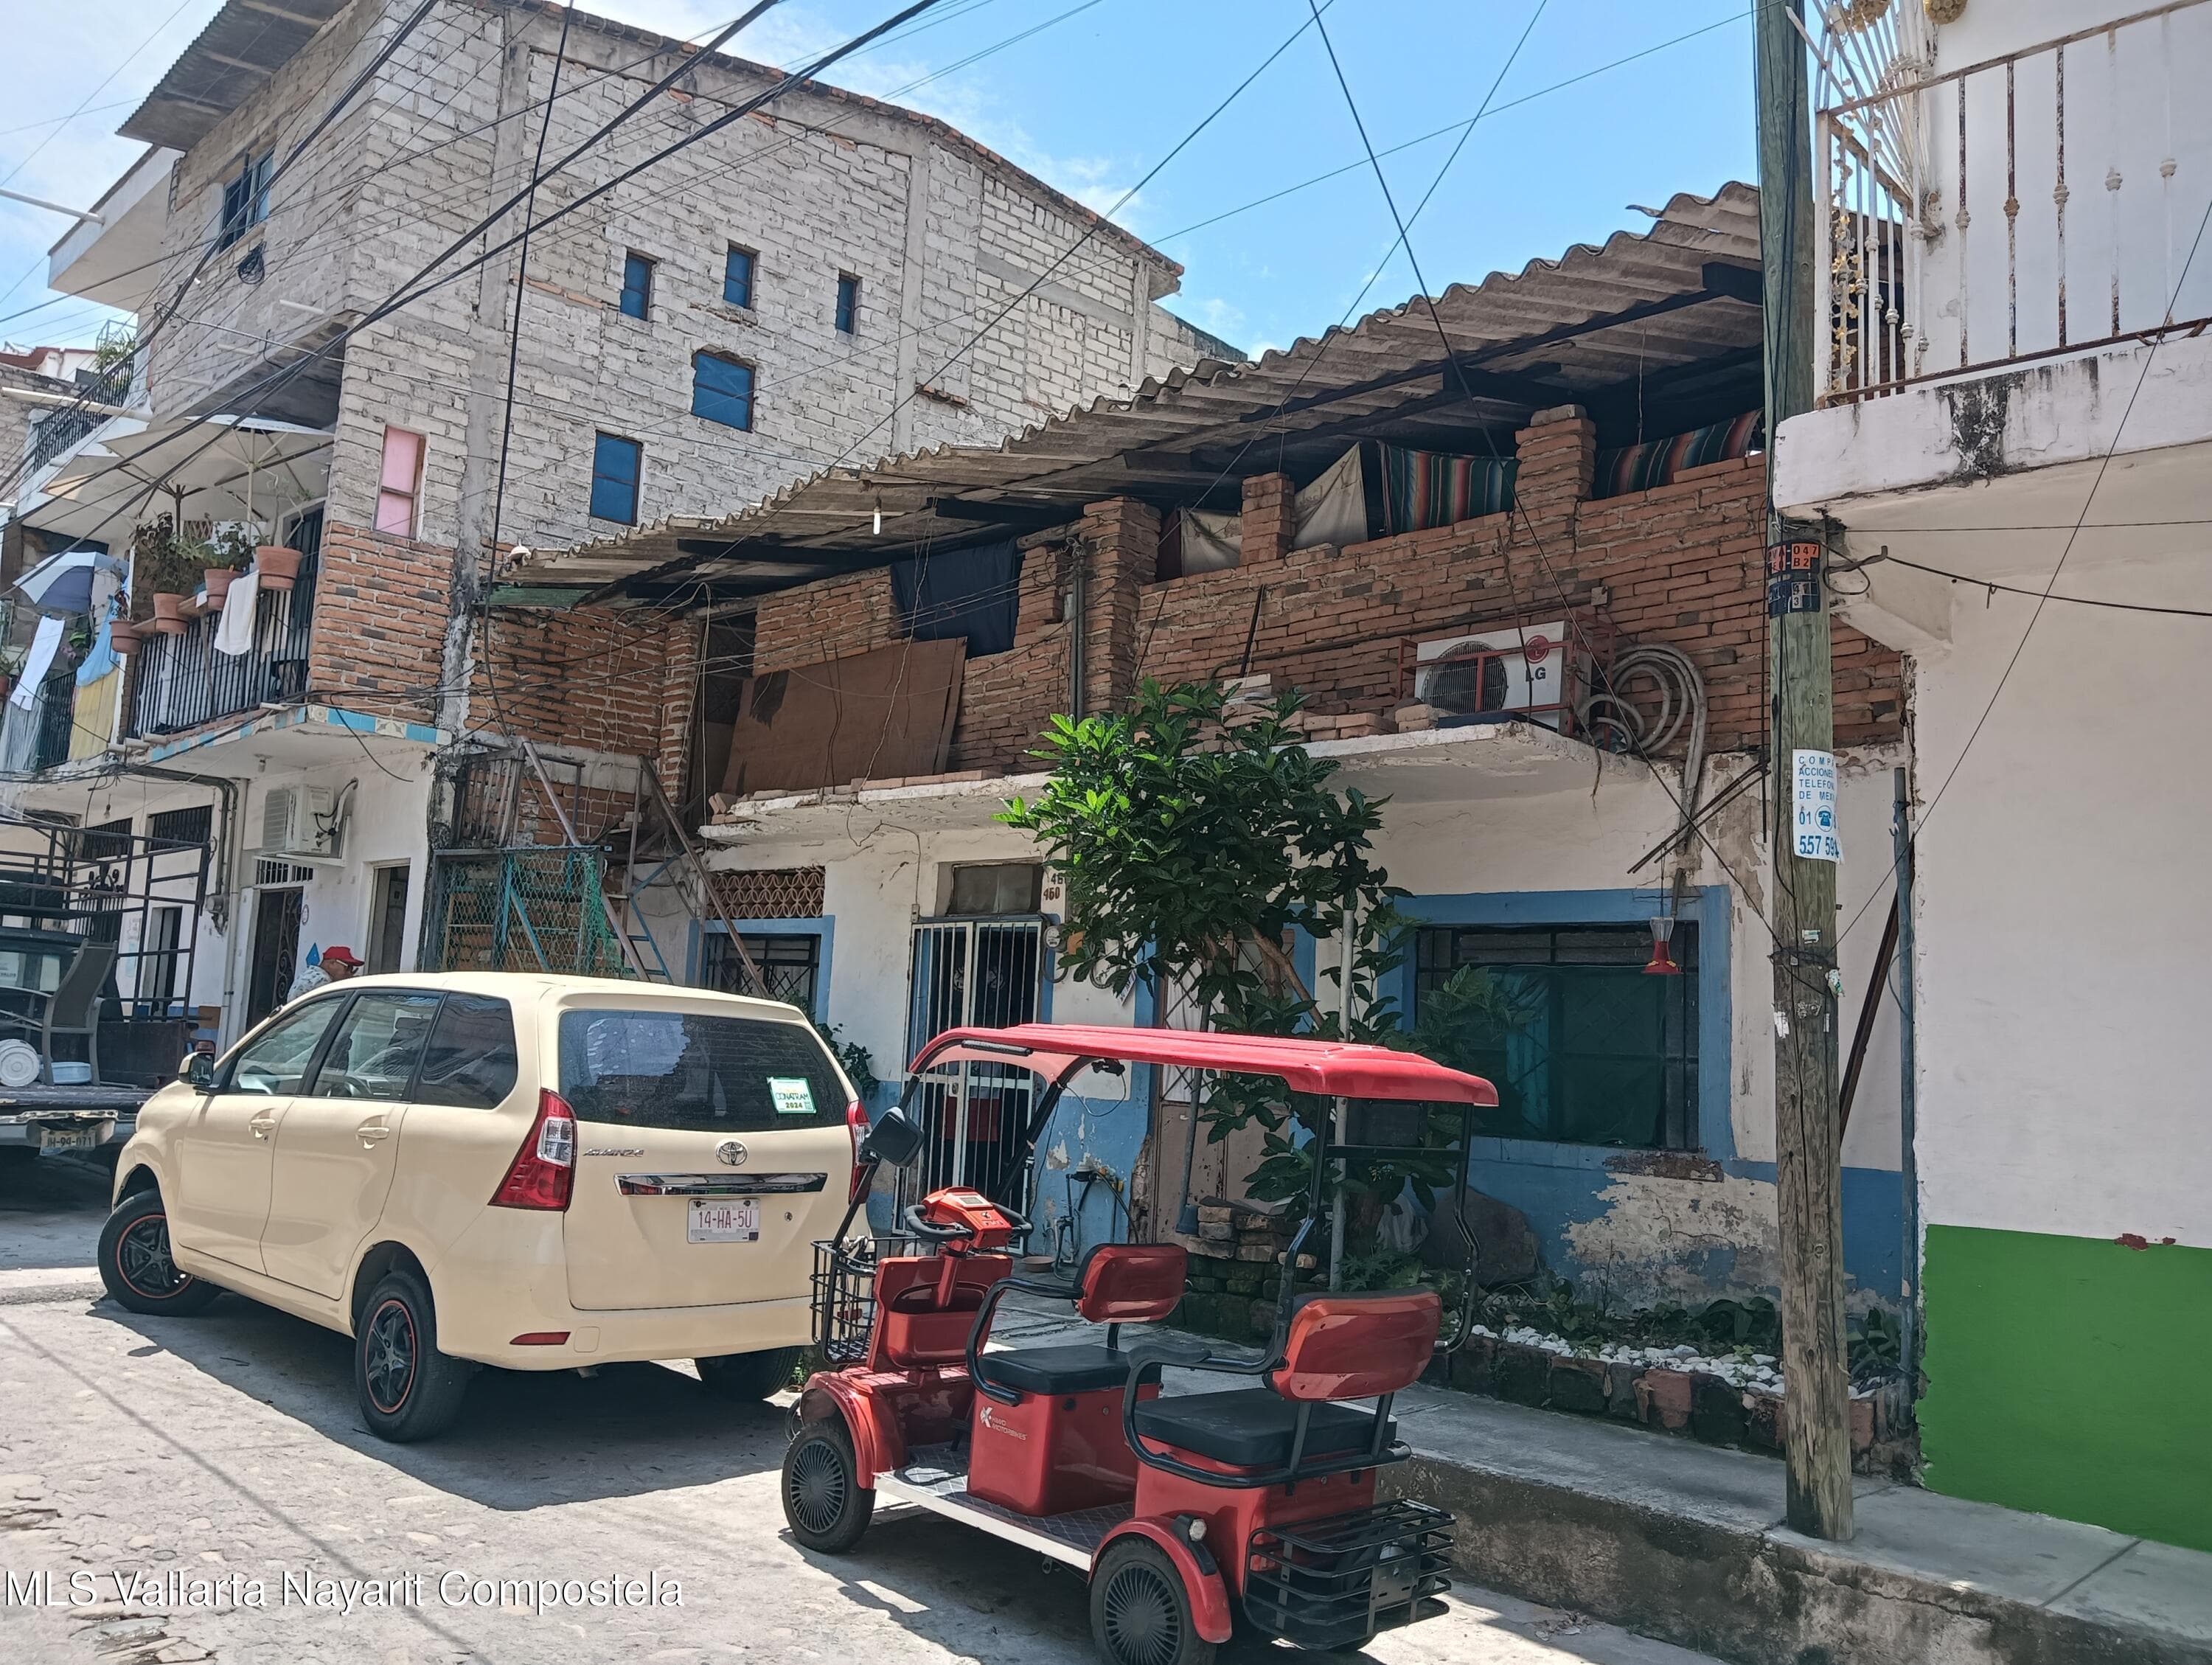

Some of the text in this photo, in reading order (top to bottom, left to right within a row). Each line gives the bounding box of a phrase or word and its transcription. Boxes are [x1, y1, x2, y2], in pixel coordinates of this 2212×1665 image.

[1526, 667, 1546, 682] LG
[1799, 790, 1812, 799] DE
[1799, 811, 1811, 825] 01
[1799, 835, 1822, 855] 557
